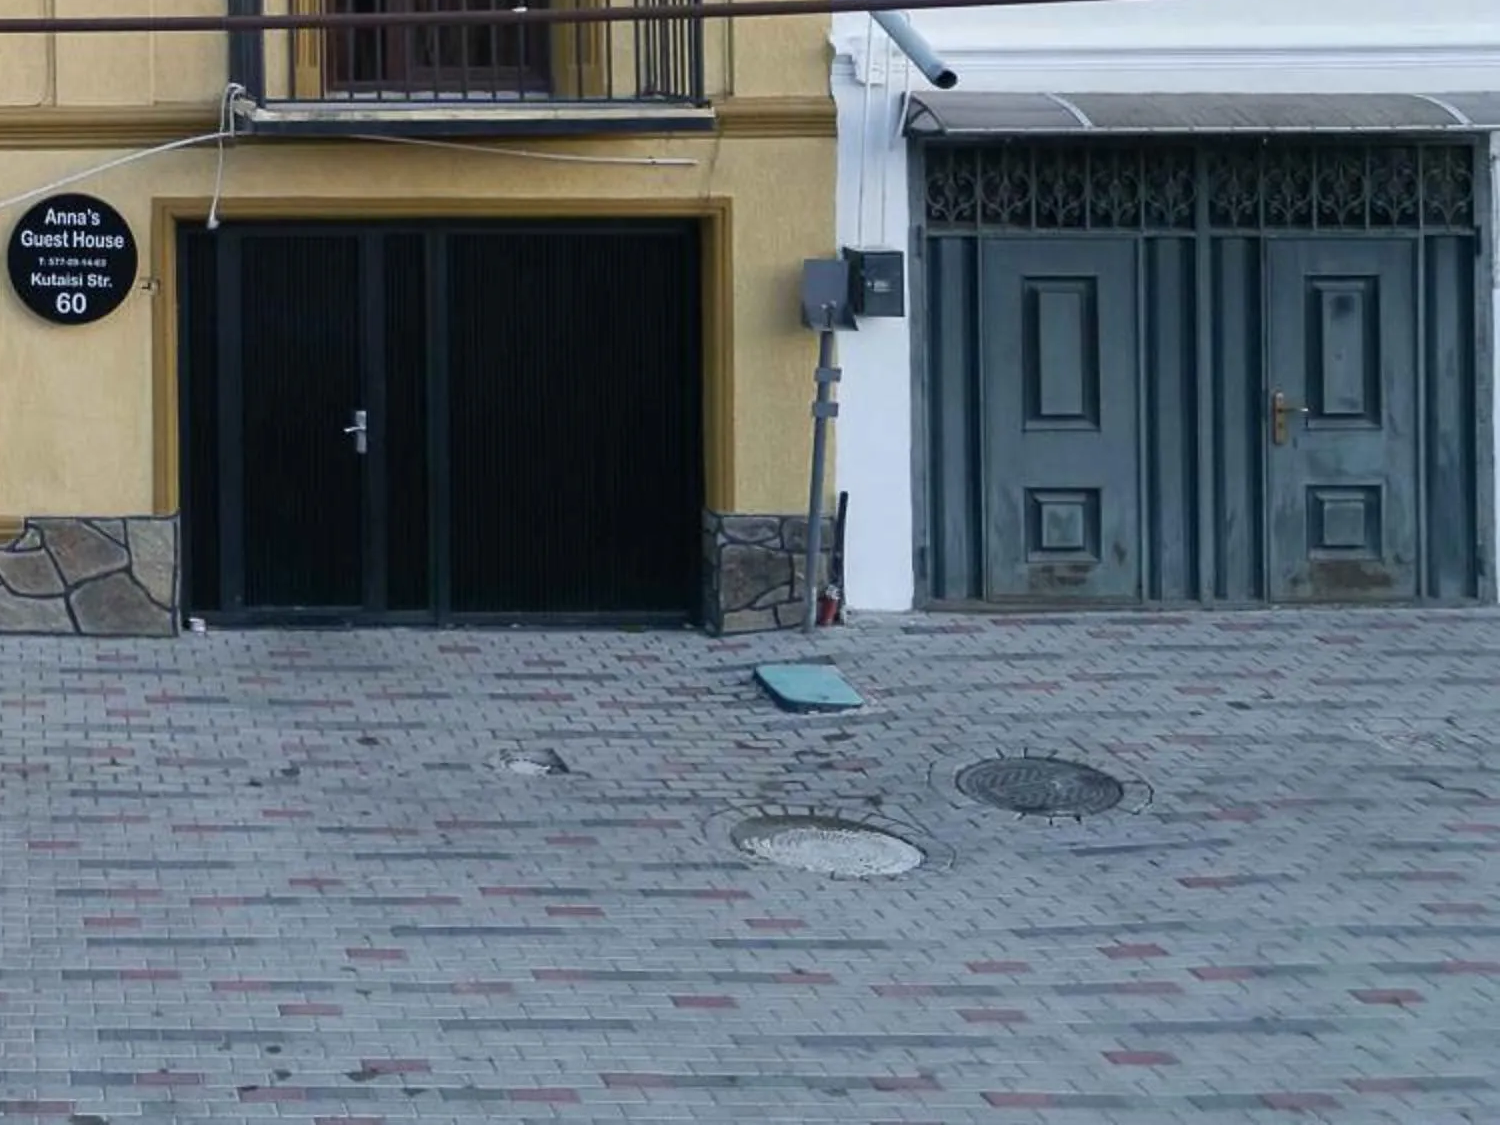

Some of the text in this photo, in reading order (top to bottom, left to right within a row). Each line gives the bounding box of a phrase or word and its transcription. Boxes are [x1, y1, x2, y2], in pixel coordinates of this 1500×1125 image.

[44, 207, 101, 226] Anna's
[20, 230, 125, 249] Guest House
[31, 272, 113, 288] Kutaisi Str.
[56, 292, 87, 314] 60
